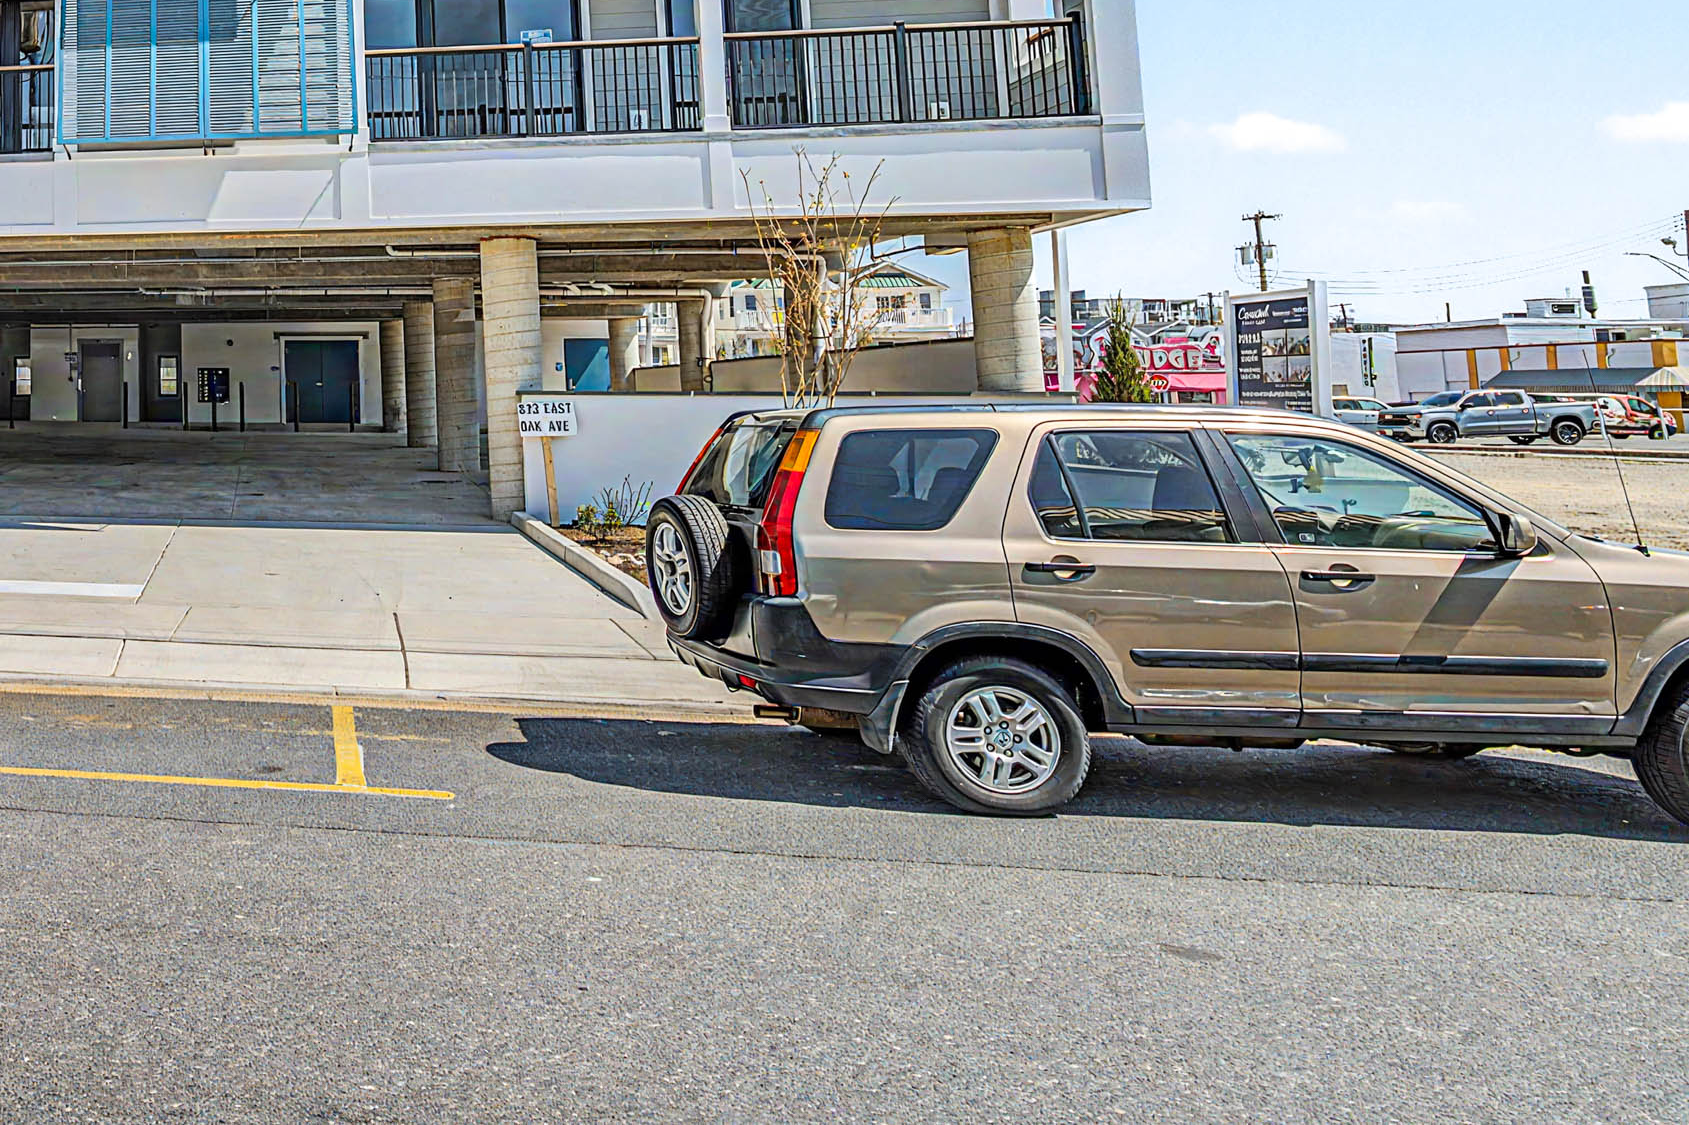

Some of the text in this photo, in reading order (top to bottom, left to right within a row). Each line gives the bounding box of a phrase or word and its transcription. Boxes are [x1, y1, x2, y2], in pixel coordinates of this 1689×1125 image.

[1135, 348, 1203, 370] UDGE
[543, 402, 571, 414] EAST
[520, 420, 570, 432] OAK AVE
